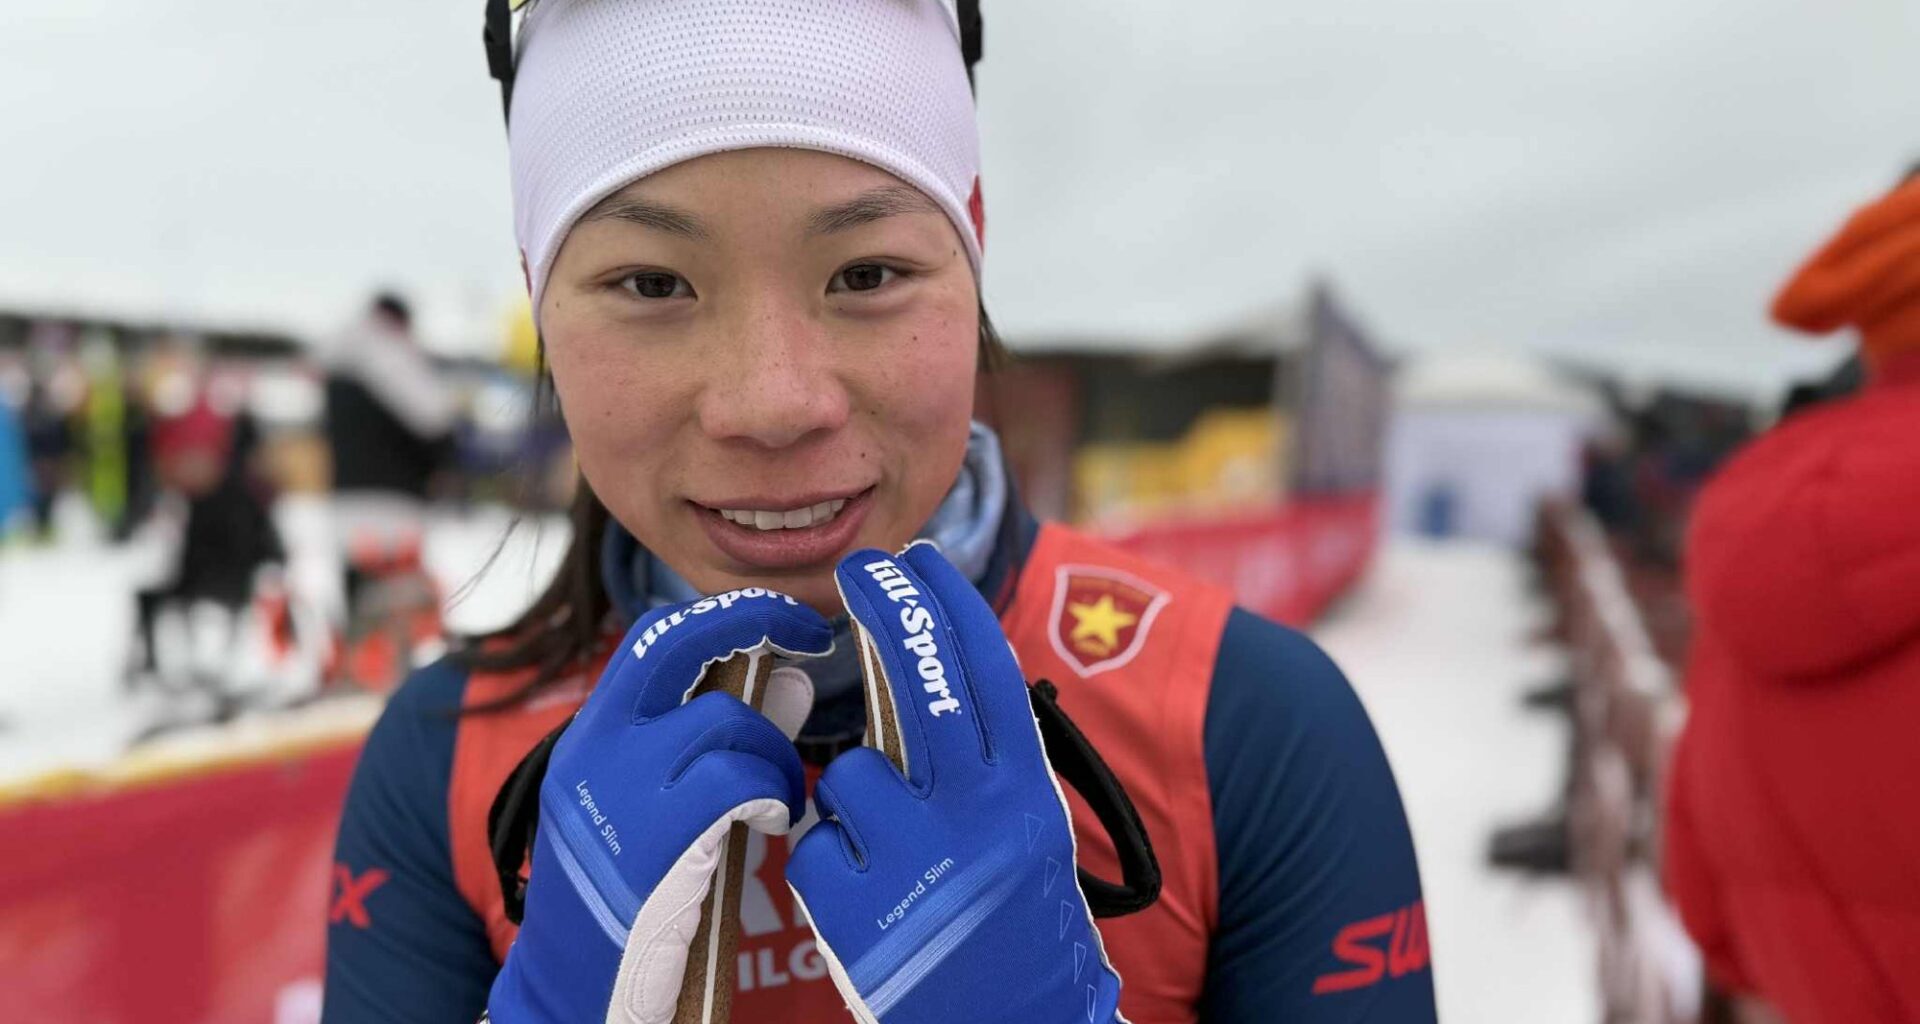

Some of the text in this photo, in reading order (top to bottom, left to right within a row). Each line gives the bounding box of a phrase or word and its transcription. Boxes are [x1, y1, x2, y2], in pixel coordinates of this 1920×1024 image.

[576, 780, 621, 855] Legend Slim
[877, 858, 954, 930] Legend Slim
